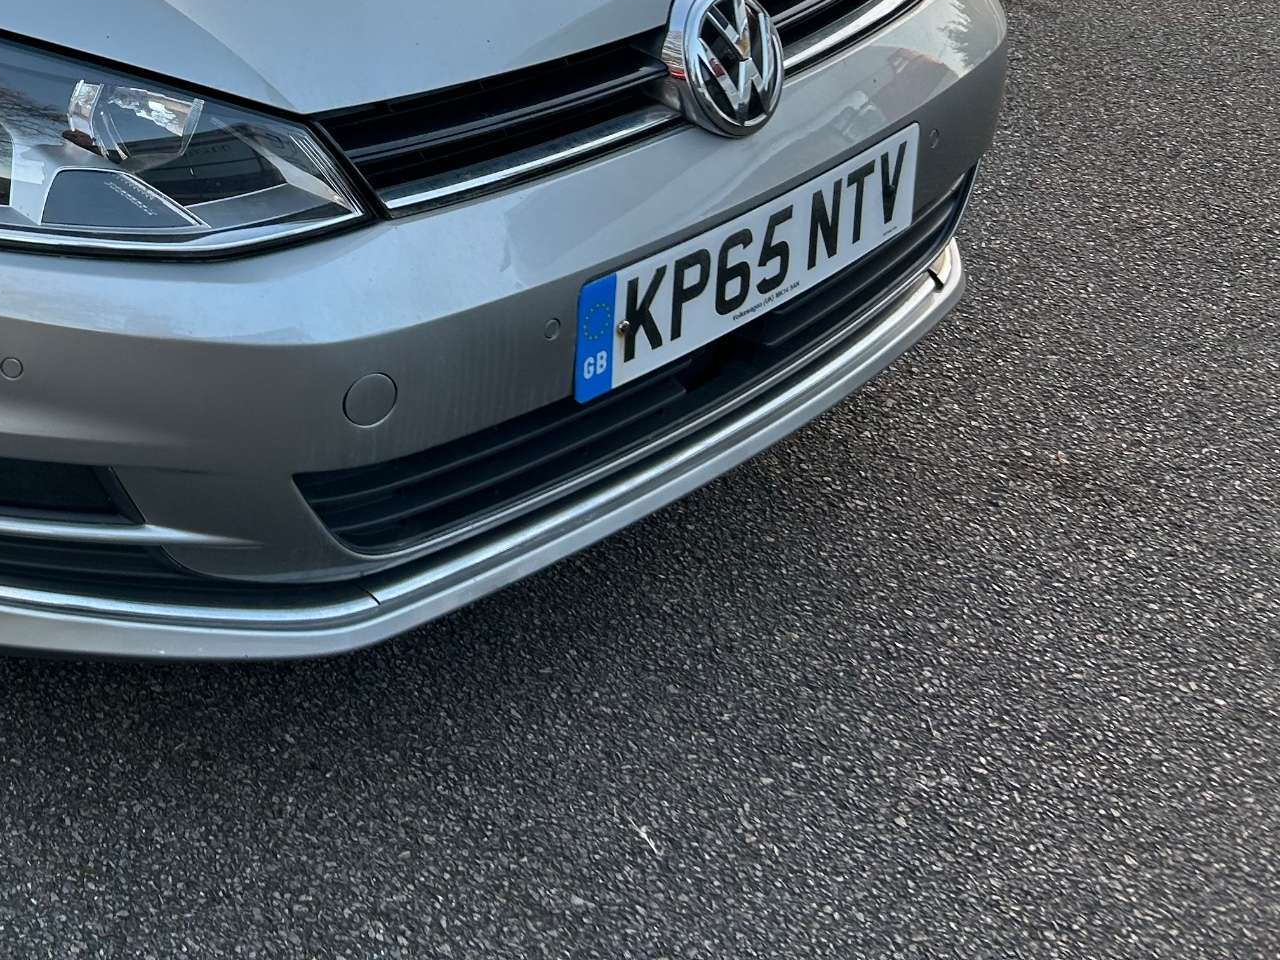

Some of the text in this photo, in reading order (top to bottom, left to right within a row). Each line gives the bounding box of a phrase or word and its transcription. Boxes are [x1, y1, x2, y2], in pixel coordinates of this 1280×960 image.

[623, 141, 908, 363] KP65 NTV
[583, 350, 608, 380] GB
